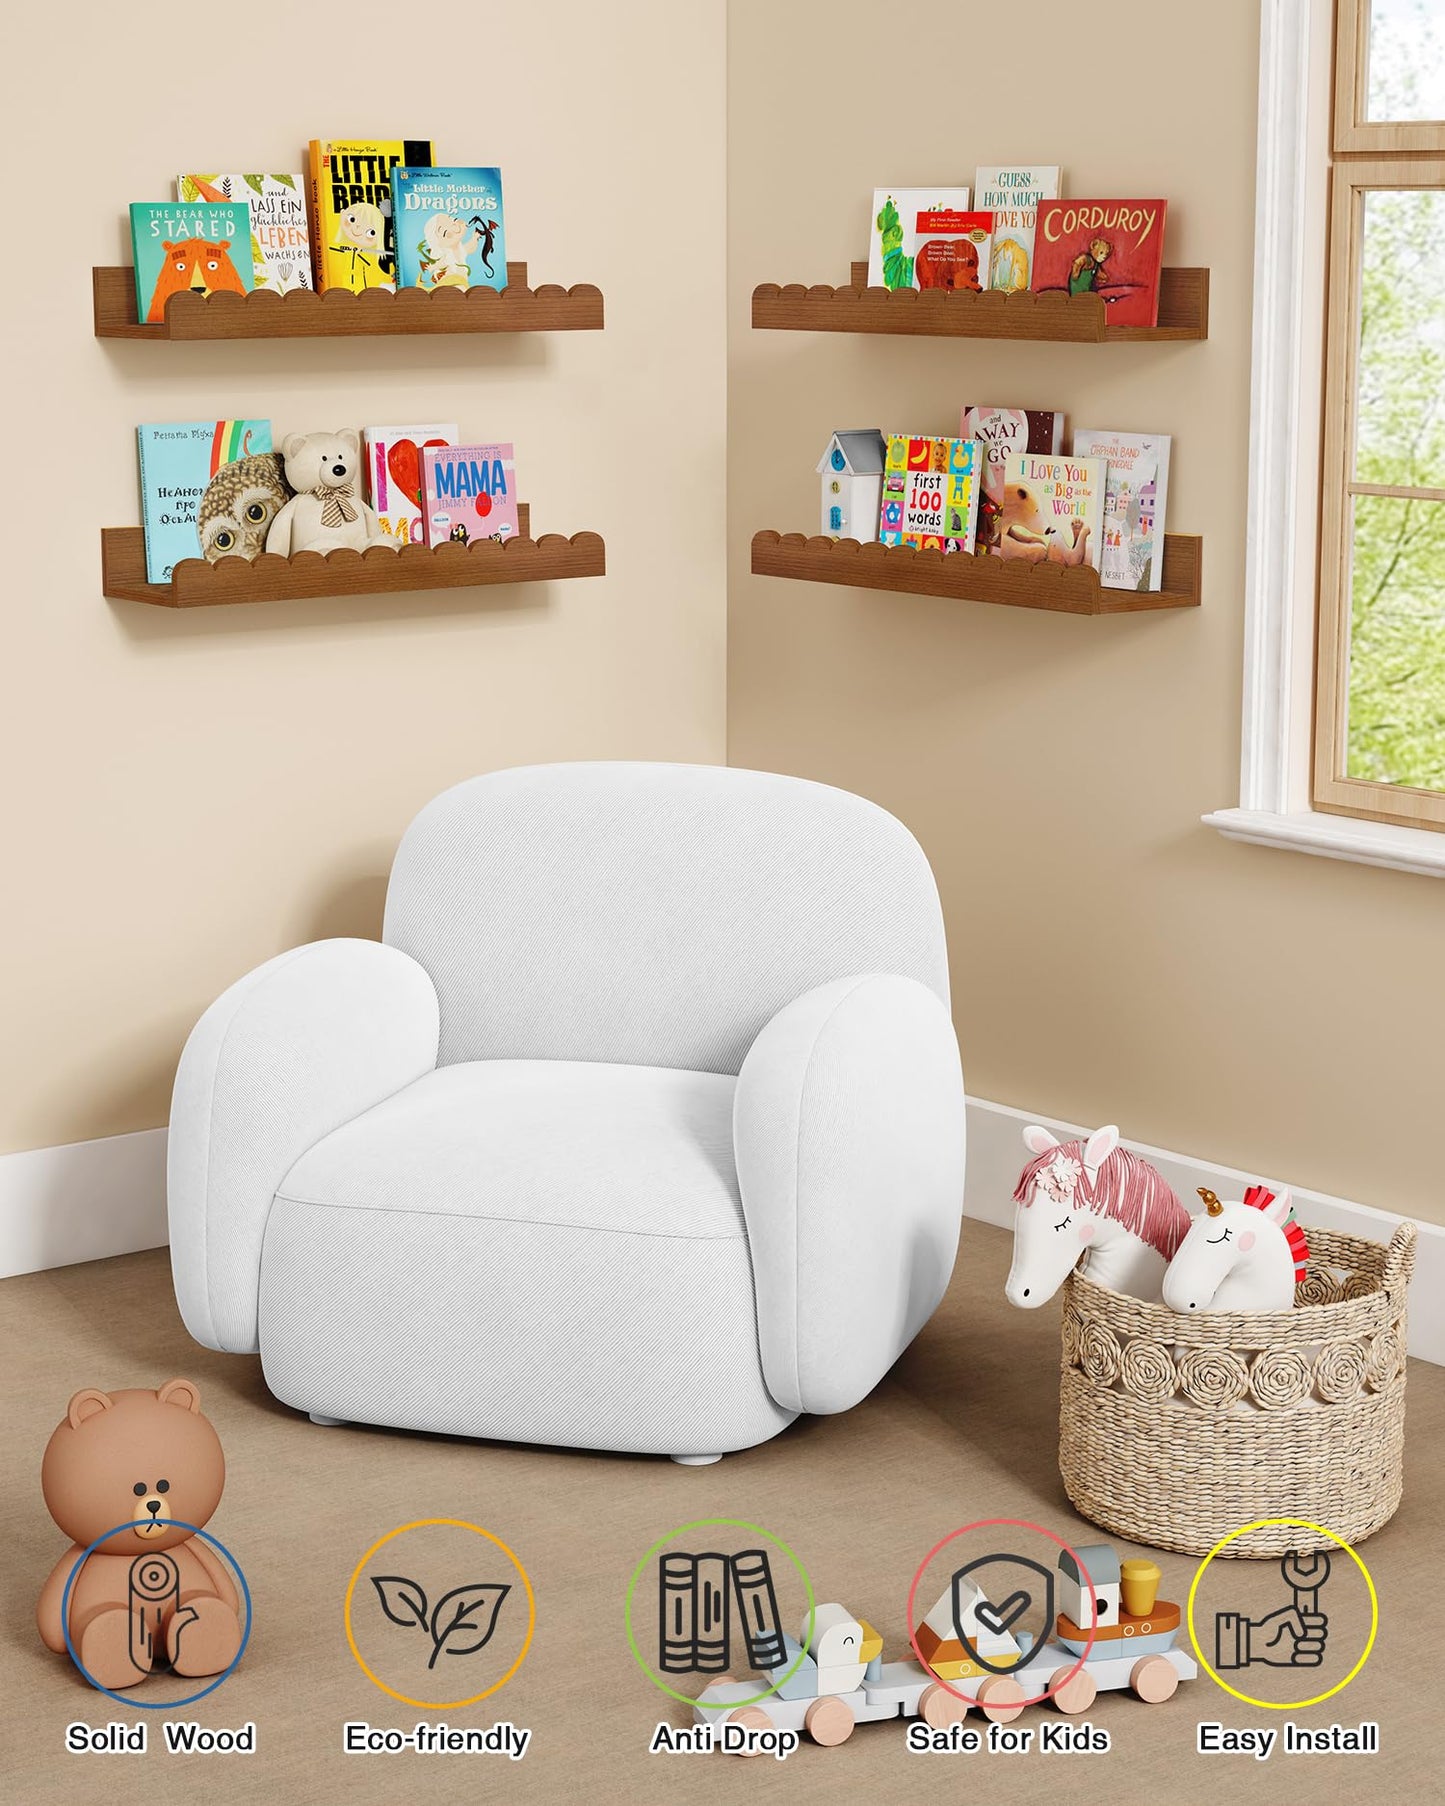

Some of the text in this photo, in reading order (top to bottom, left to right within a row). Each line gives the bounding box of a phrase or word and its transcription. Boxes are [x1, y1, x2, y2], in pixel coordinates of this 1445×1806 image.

[322, 155, 330, 168] THE
[998, 172, 1032, 188] GUESS
[412, 184, 444, 193] Little
[446, 184, 486, 193] Mother
[250, 198, 276, 214] LASS
[404, 193, 498, 214] Dragons
[984, 192, 1010, 208] HOW
[149, 209, 234, 218] THE BEAR WHO
[150, 219, 236, 238] STARED
[1044, 206, 1157, 254] CORDUROY
[259, 226, 309, 249] LEBEN
[264, 250, 310, 261] WACHSEN
[974, 422, 1020, 443] AWAY
[434, 450, 502, 462] EVERYTHING IS
[1120, 446, 1140, 458] BAND
[376, 442, 388, 512] I
[1021, 460, 1088, 482] I Love You
[434, 460, 508, 499] MAMA
[914, 472, 942, 489] first
[1044, 484, 1054, 494] as
[1055, 482, 1073, 500] Big
[438, 498, 468, 511] JIMMY
[910, 488, 942, 512] 100
[1052, 500, 1086, 516] World
[908, 512, 942, 526] words
